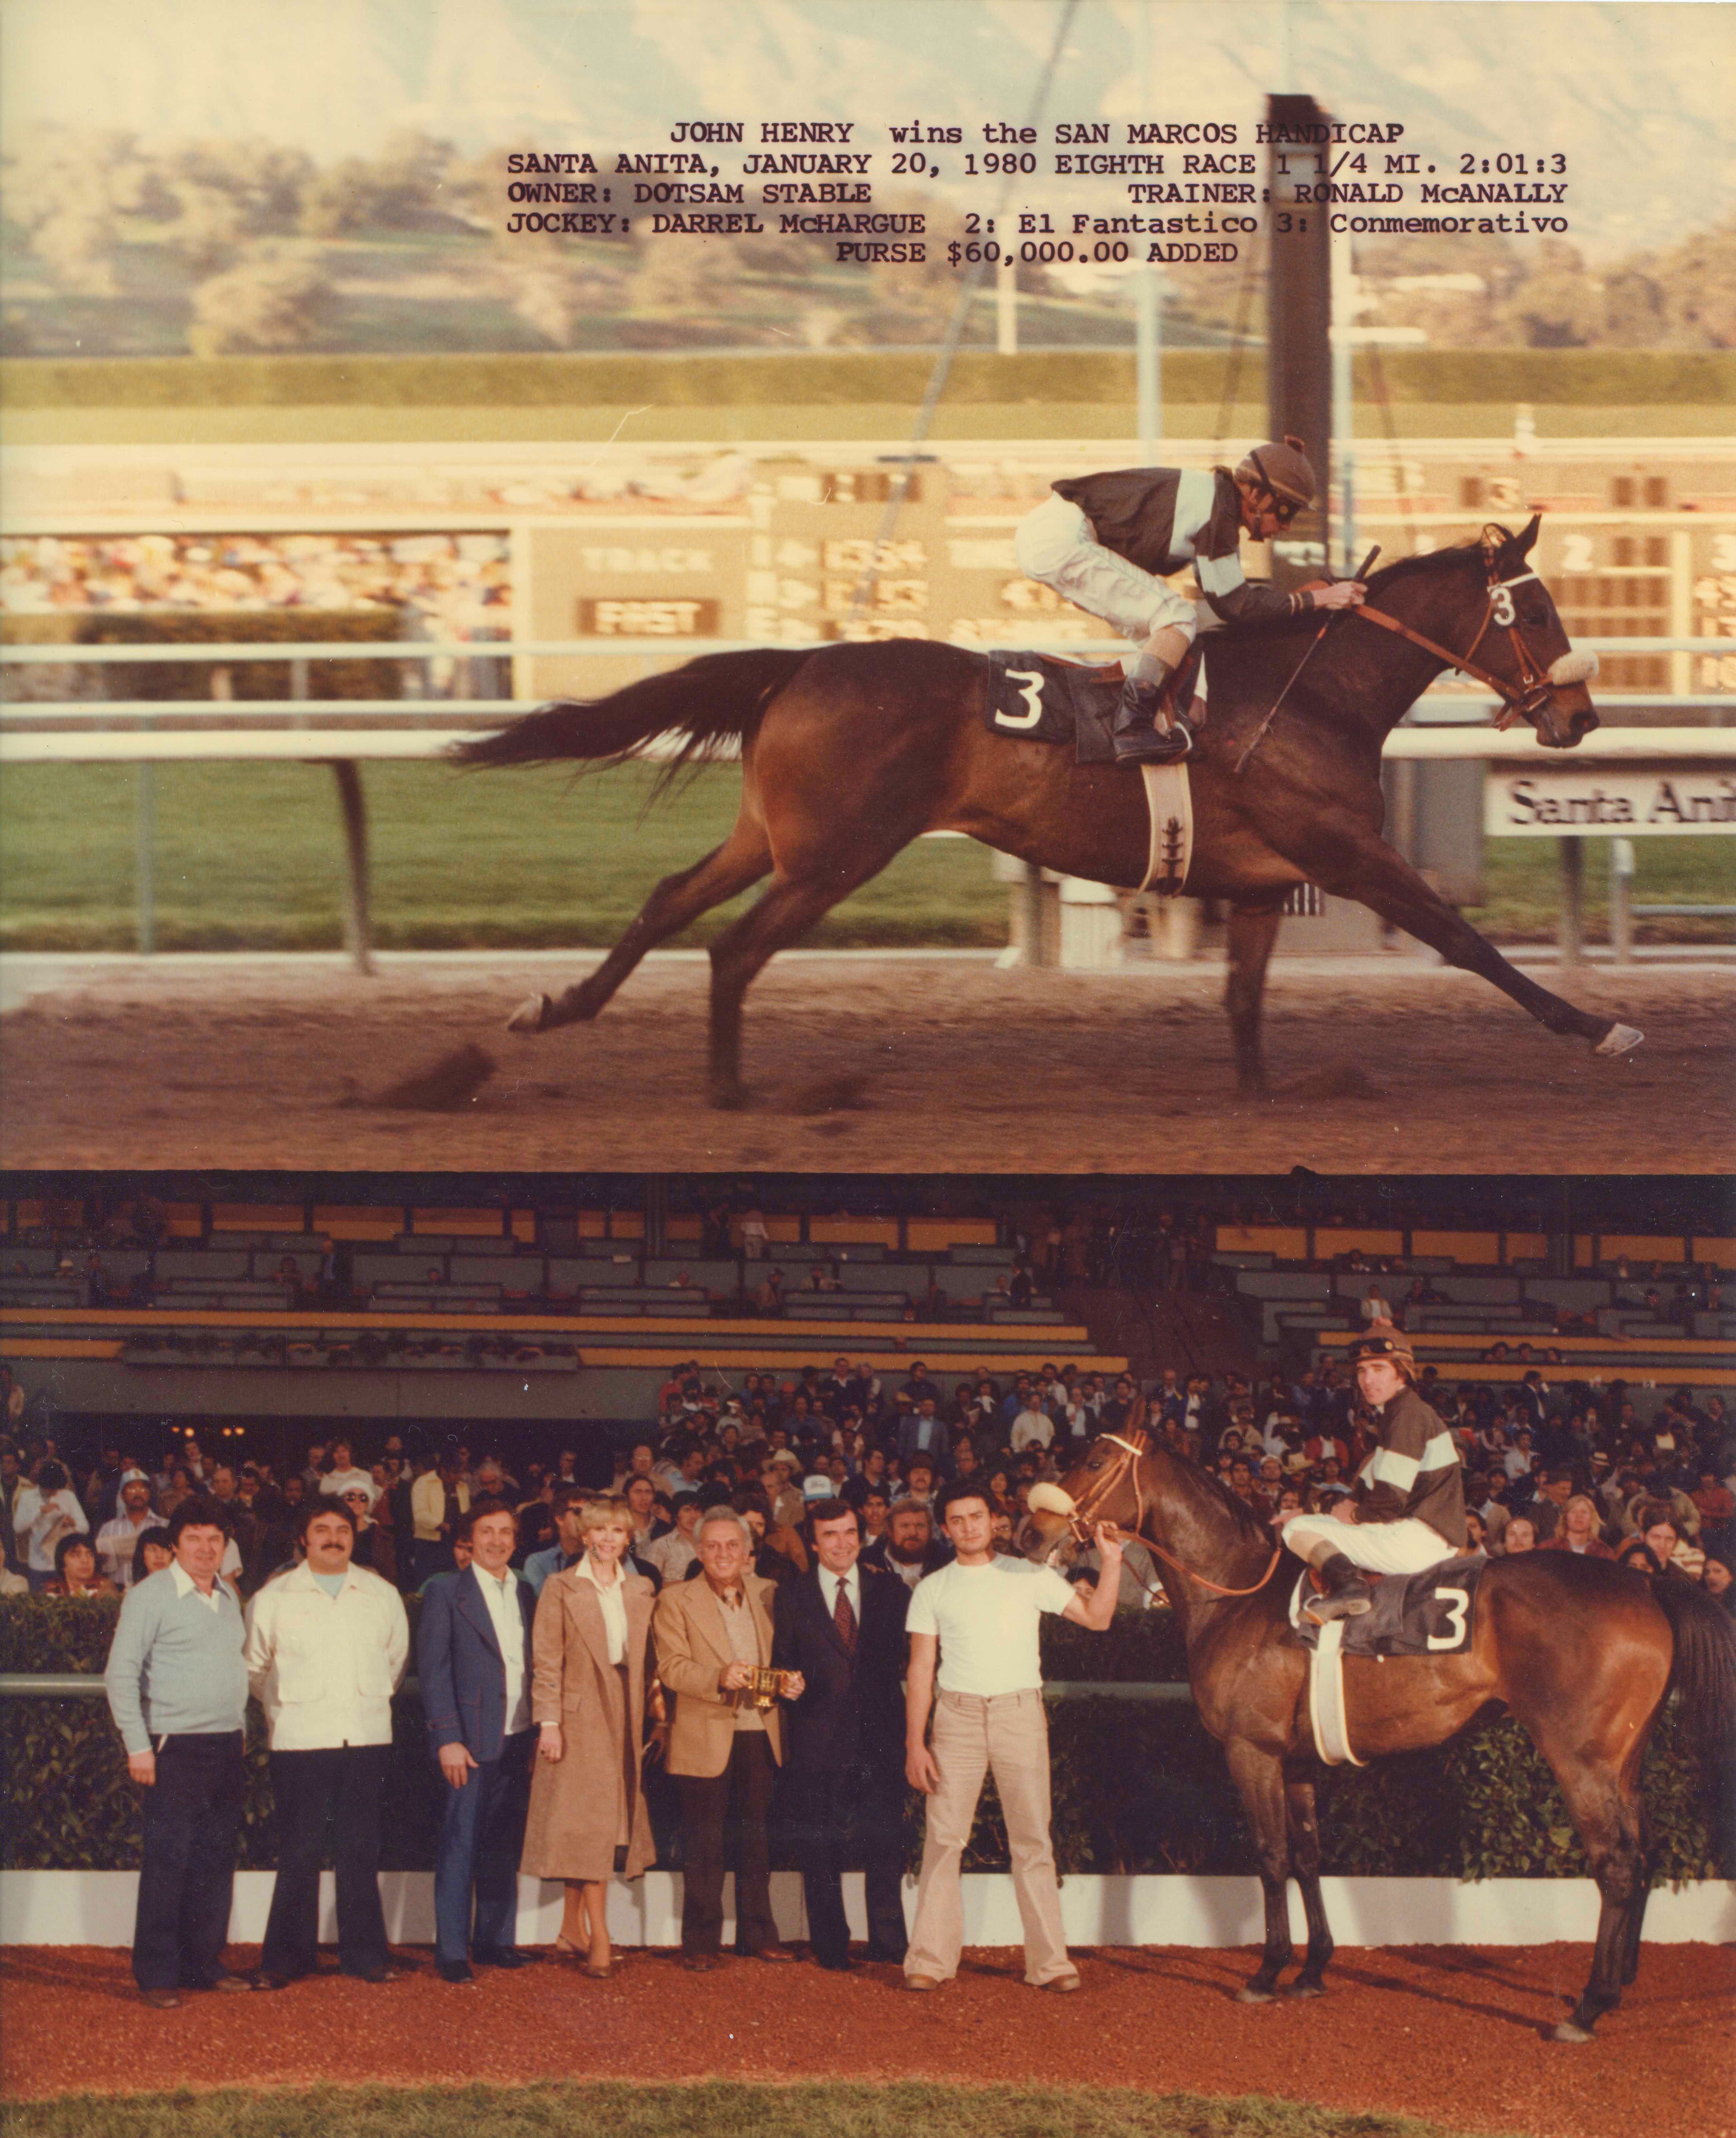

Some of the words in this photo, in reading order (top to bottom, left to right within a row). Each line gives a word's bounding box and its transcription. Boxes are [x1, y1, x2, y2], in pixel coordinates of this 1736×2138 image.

[1491, 587, 1516, 627] 3
[994, 668, 1046, 729] 3
[1510, 780, 1636, 825] Santa
[1427, 1587, 1470, 1650] 3
